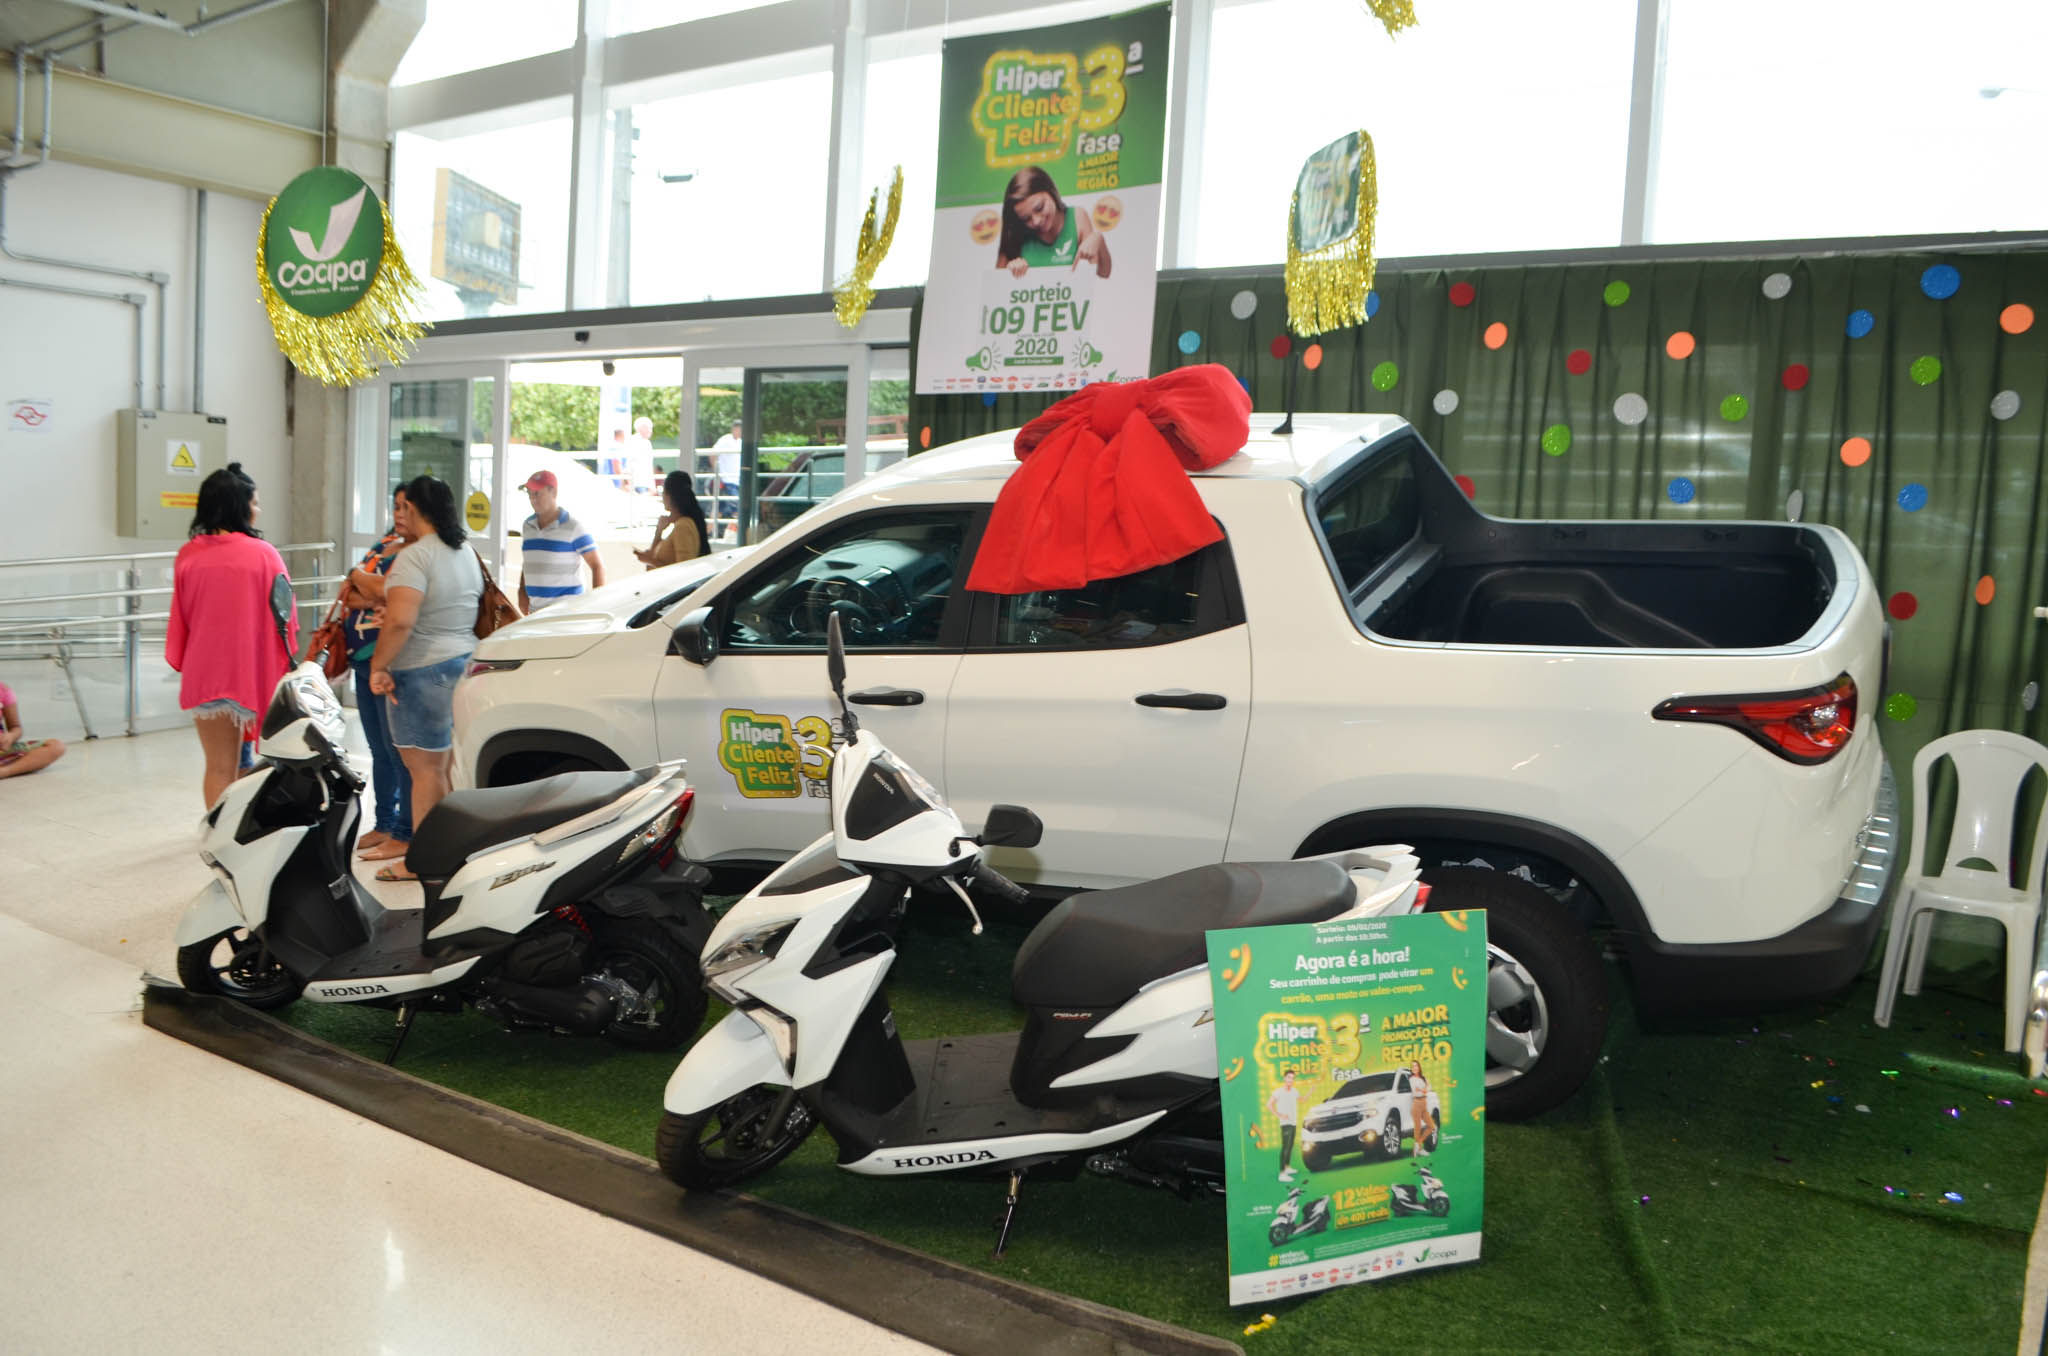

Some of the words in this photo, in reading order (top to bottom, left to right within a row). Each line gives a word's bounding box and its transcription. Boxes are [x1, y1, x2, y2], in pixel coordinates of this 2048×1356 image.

[995, 66, 1065, 96] Hiper
[986, 92, 1074, 120] Cliente
[1003, 119, 1061, 148] Feliz
[1076, 132, 1121, 156] fase
[1077, 173, 1119, 190] REGIÃO
[1010, 282, 1071, 303] sorteio
[989, 306, 1025, 334] 09
[1033, 300, 1090, 333] FEV
[1014, 338, 1058, 356] 2020
[730, 721, 782, 745] Hiper
[728, 743, 794, 764] Cliente
[745, 765, 792, 785] Feliz
[1295, 954, 1345, 974] Agora
[1348, 949, 1358, 967] é
[1360, 954, 1370, 966] a
[1372, 946, 1410, 965] hora!
[1269, 979, 1288, 989] Seu
[1288, 974, 1328, 988] carrinho
[1329, 974, 1340, 985] de
[1341, 972, 1376, 985] compras
[1378, 969, 1399, 982] pode
[1399, 967, 1418, 978] virar
[1419, 967, 1434, 976] um
[320, 984, 391, 997] HONDA
[1281, 992, 1314, 1005] carrão,
[1315, 992, 1335, 1002] uma
[1381, 1016, 1392, 1031] A
[1393, 1004, 1449, 1028] MAIOR
[1268, 1022, 1317, 1042] Hiper
[1381, 1026, 1431, 1043] PROMOÇÃO
[1432, 1026, 1449, 1037] DA
[1265, 1040, 1326, 1058] Cliente
[1382, 1038, 1453, 1063] REGIÃO
[1279, 1058, 1320, 1076] Feliz
[1332, 1067, 1361, 1081] fase
[893, 1149, 998, 1169] HONDA
[1332, 1187, 1355, 1211] 12
